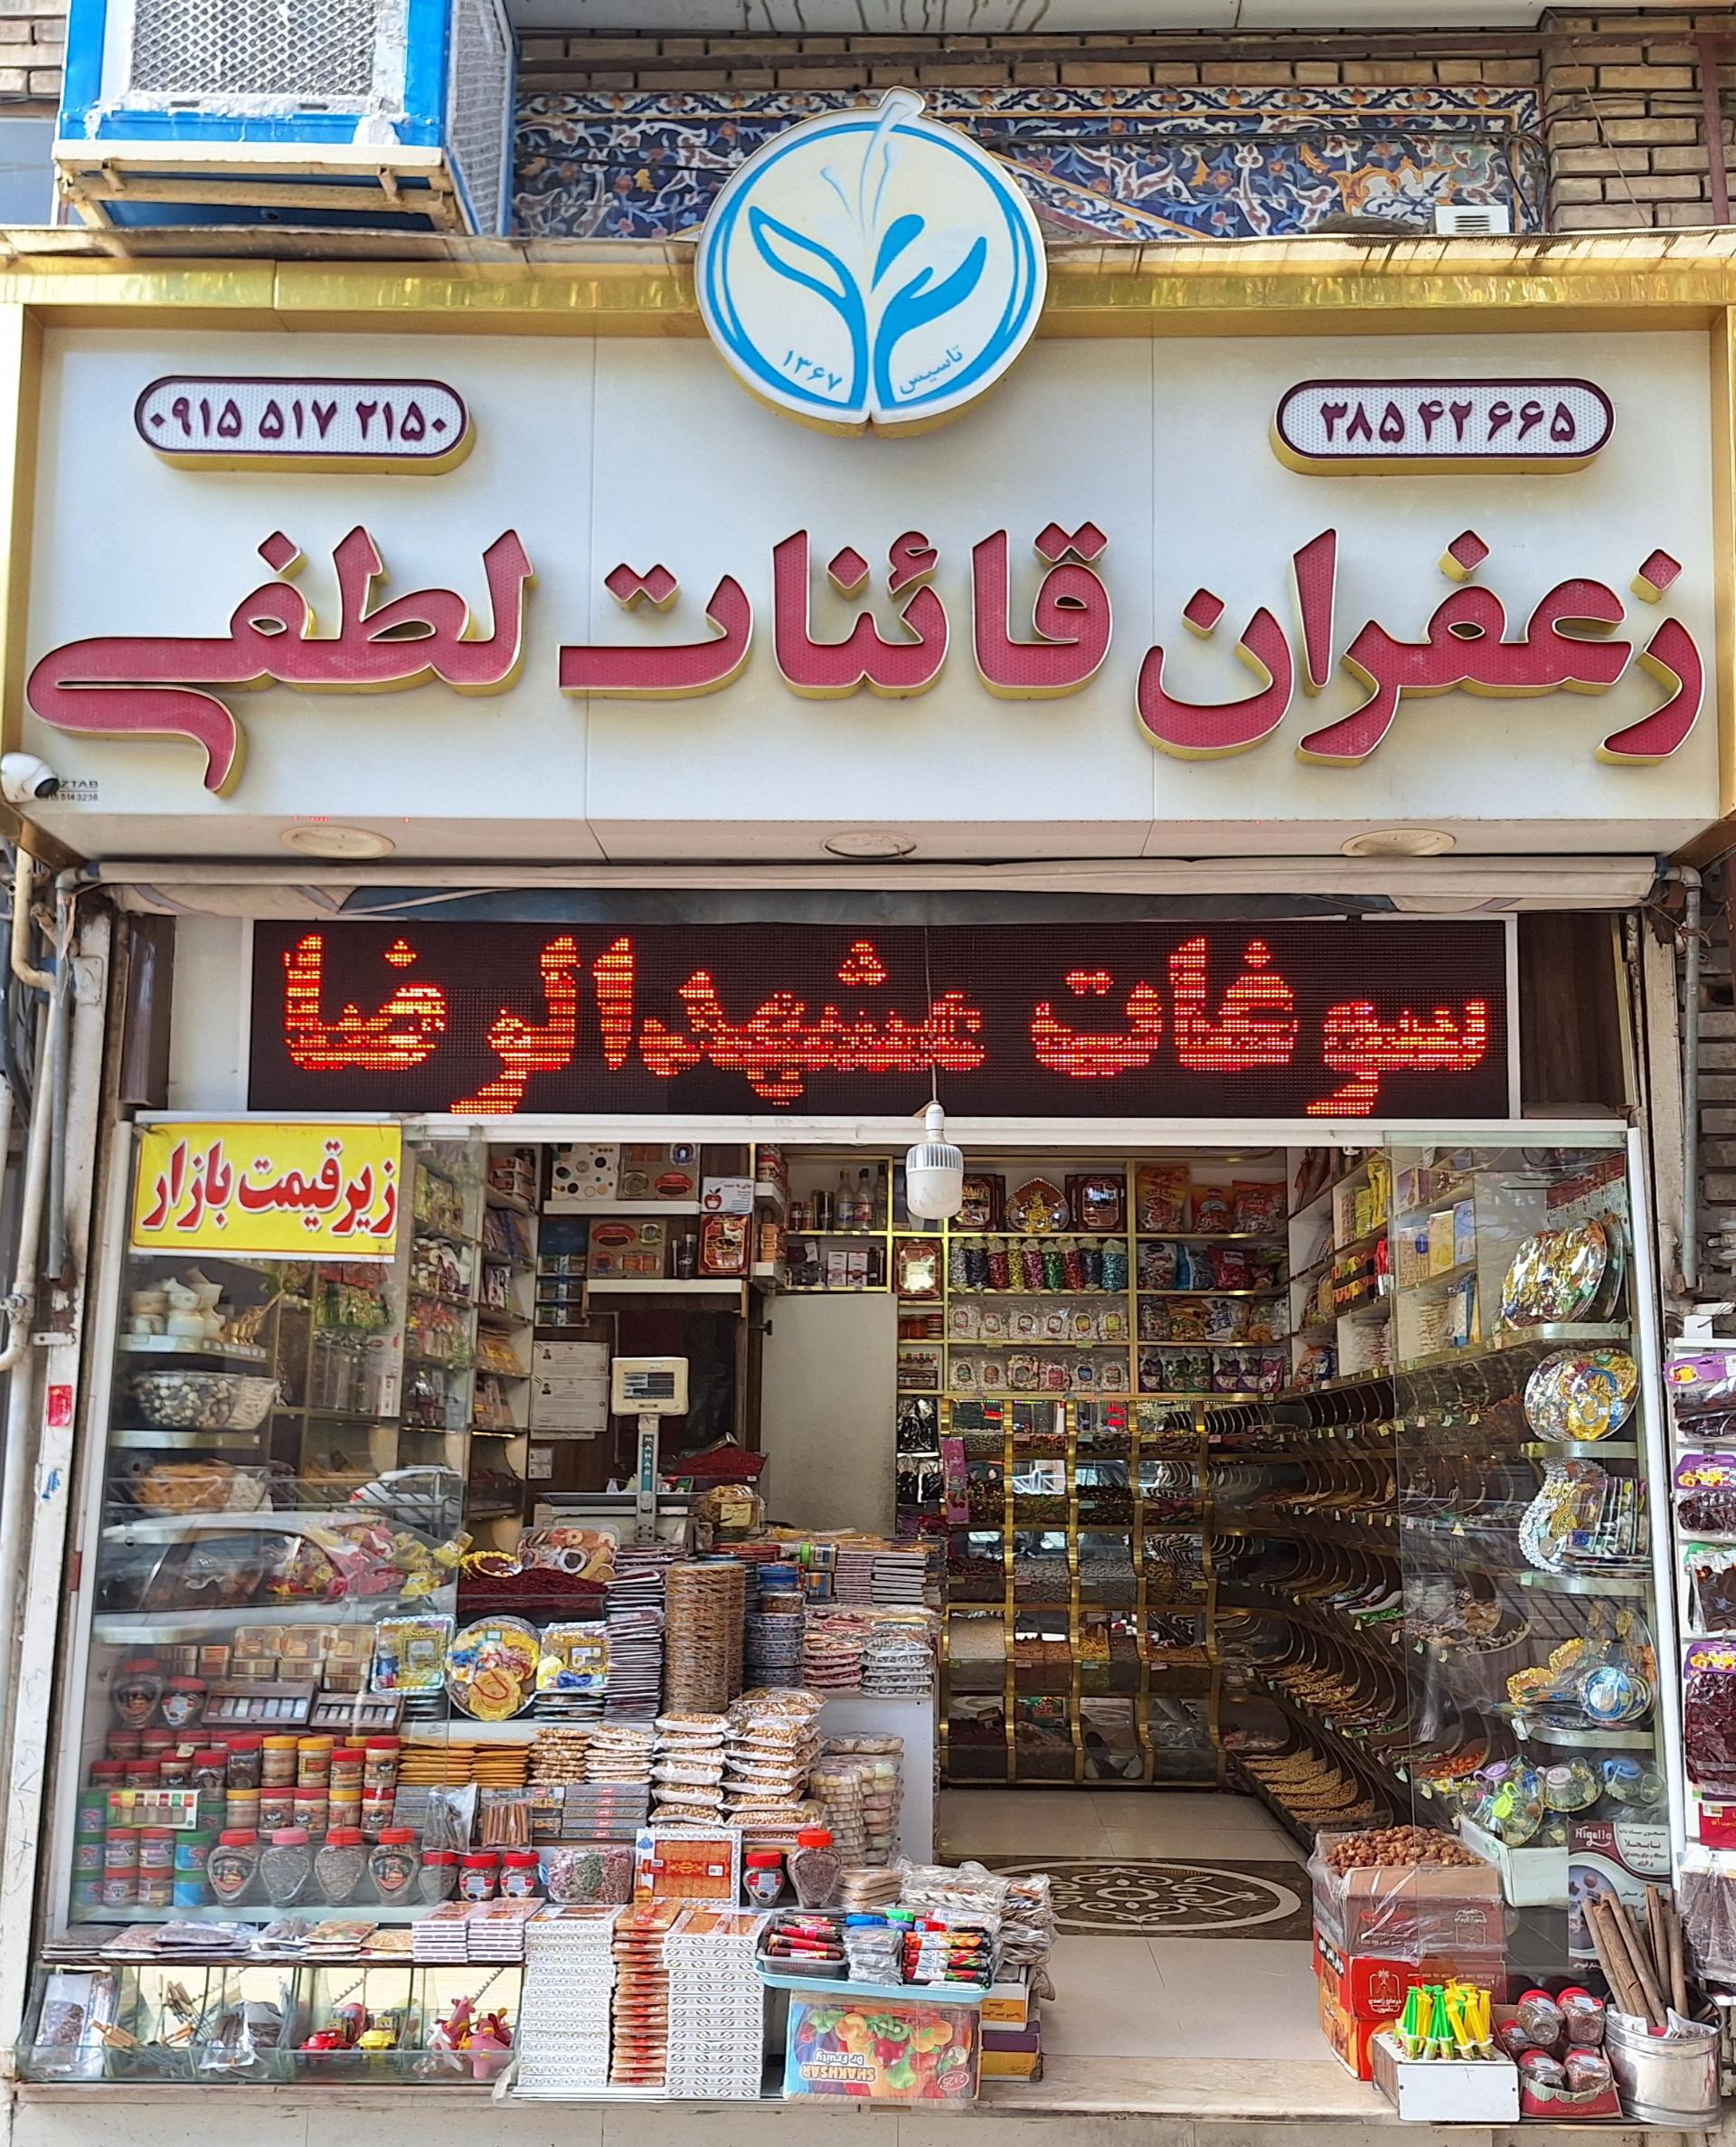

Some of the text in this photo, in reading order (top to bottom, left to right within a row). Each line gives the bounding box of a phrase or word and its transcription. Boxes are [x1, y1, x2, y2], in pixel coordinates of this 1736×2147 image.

[782, 349, 843, 393] ۱۳۶۷
[899, 345, 964, 395] تاسیس
[149, 396, 448, 442] ۰۹۱۵ ۵۱۷ ۲۱۵۰
[1320, 400, 1577, 443] ۳۸۵ ۴۲ ۶۶۵
[26, 519, 1704, 797] زعفران قائنات لطفی
[1030, 936, 1490, 1116] سوغات
[141, 1139, 398, 1235] زیر قیمت بازار
[643, 1435, 654, 1477] MAHAK
[1575, 1825, 1613, 1848] Nigella
[802, 2065, 876, 2083] SHAKHSAR
[815, 2049, 864, 2066] Dr Fruity
